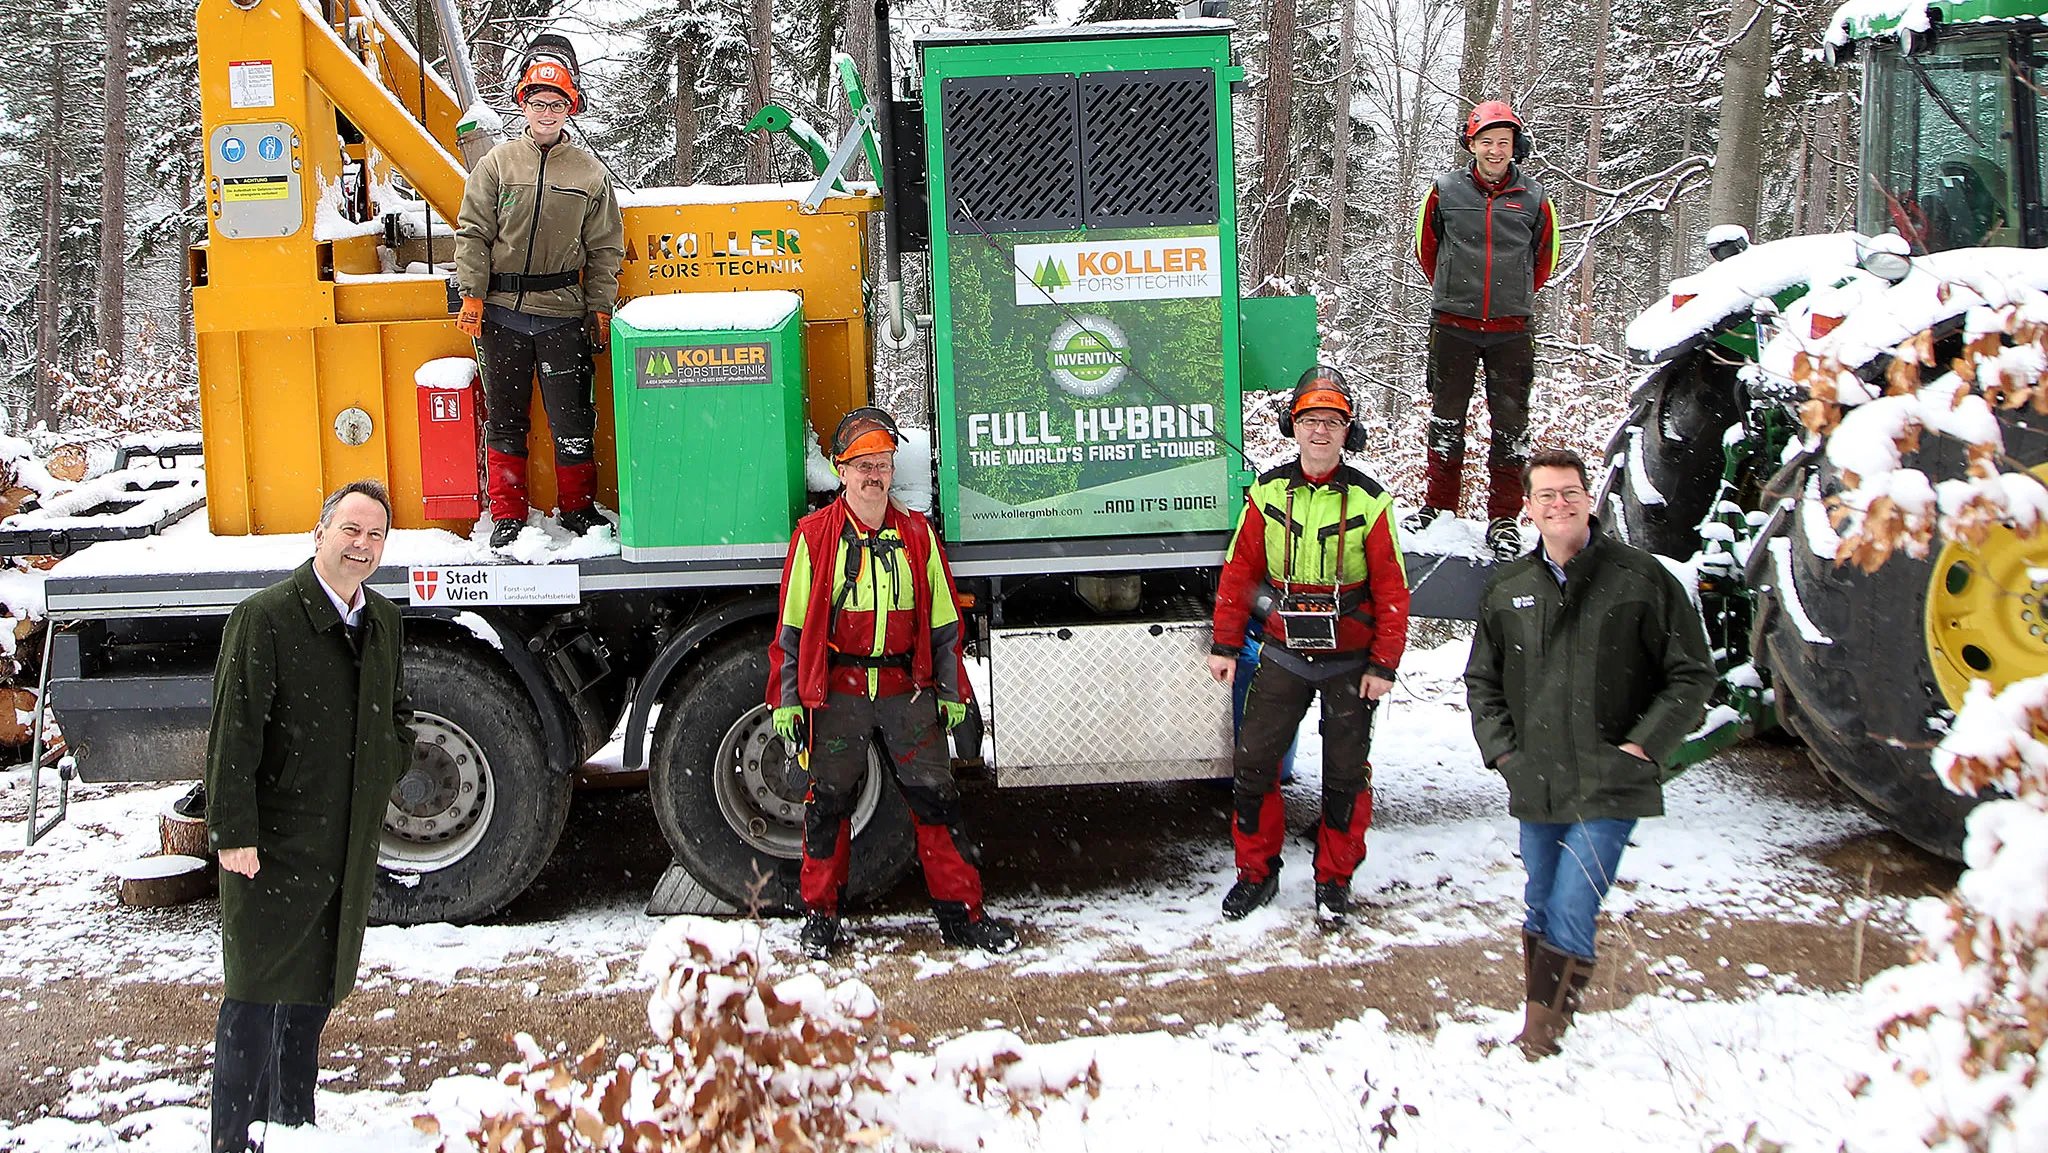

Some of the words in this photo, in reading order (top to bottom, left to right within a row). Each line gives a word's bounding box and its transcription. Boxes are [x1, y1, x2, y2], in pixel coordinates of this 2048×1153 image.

[647, 228, 802, 260] KOLLER
[649, 258, 804, 278] FORSTTECHNIK
[1077, 247, 1208, 276] KOLLER
[1078, 273, 1209, 292] FORSTTECHNIK
[1078, 336, 1098, 347] THE
[676, 346, 766, 367] KOLLER
[1054, 351, 1123, 367] INVENTIVE
[677, 364, 767, 378] FORSTTECHNIK
[968, 410, 1061, 447] FULL
[1074, 403, 1215, 442] HYBRID
[969, 450, 1001, 467] THE
[1007, 446, 1083, 465] WORLD'S
[1089, 443, 1136, 462] FIRST
[1142, 440, 1216, 460] E-TOWER
[1093, 499, 1135, 515] ...AND
[1141, 497, 1168, 512] IT'S
[1173, 495, 1217, 511] DONE!
[972, 507, 1083, 521] www.kollergmbh.com
[446, 570, 488, 584] Stadt
[446, 587, 489, 601] Wien
[503, 585, 523, 593] Forst-
[523, 585, 536, 593] und
[504, 592, 576, 600] Landwirtschaftsbetrieb
